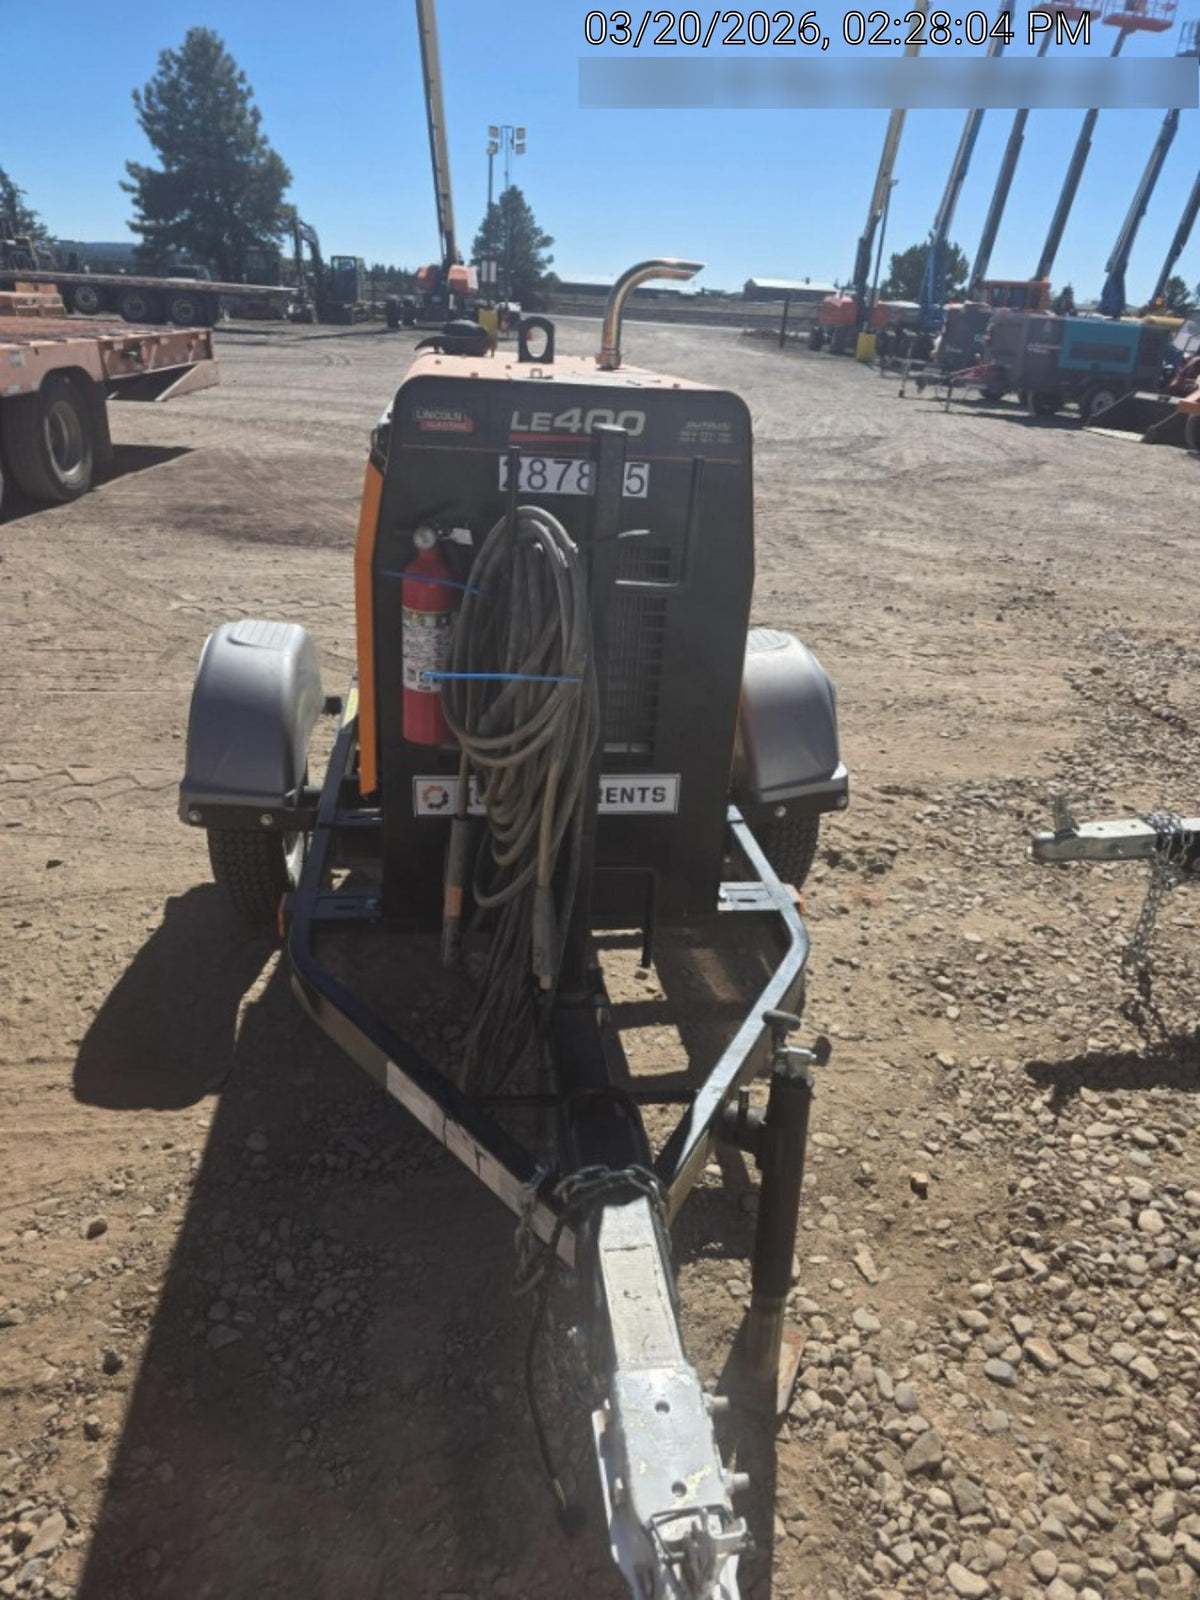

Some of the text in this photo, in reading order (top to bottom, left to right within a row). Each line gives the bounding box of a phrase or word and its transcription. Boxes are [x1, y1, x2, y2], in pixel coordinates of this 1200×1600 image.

[510, 407, 647, 438] LE400
[502, 457, 646, 495] 8785
[598, 786, 667, 805] ENTS
